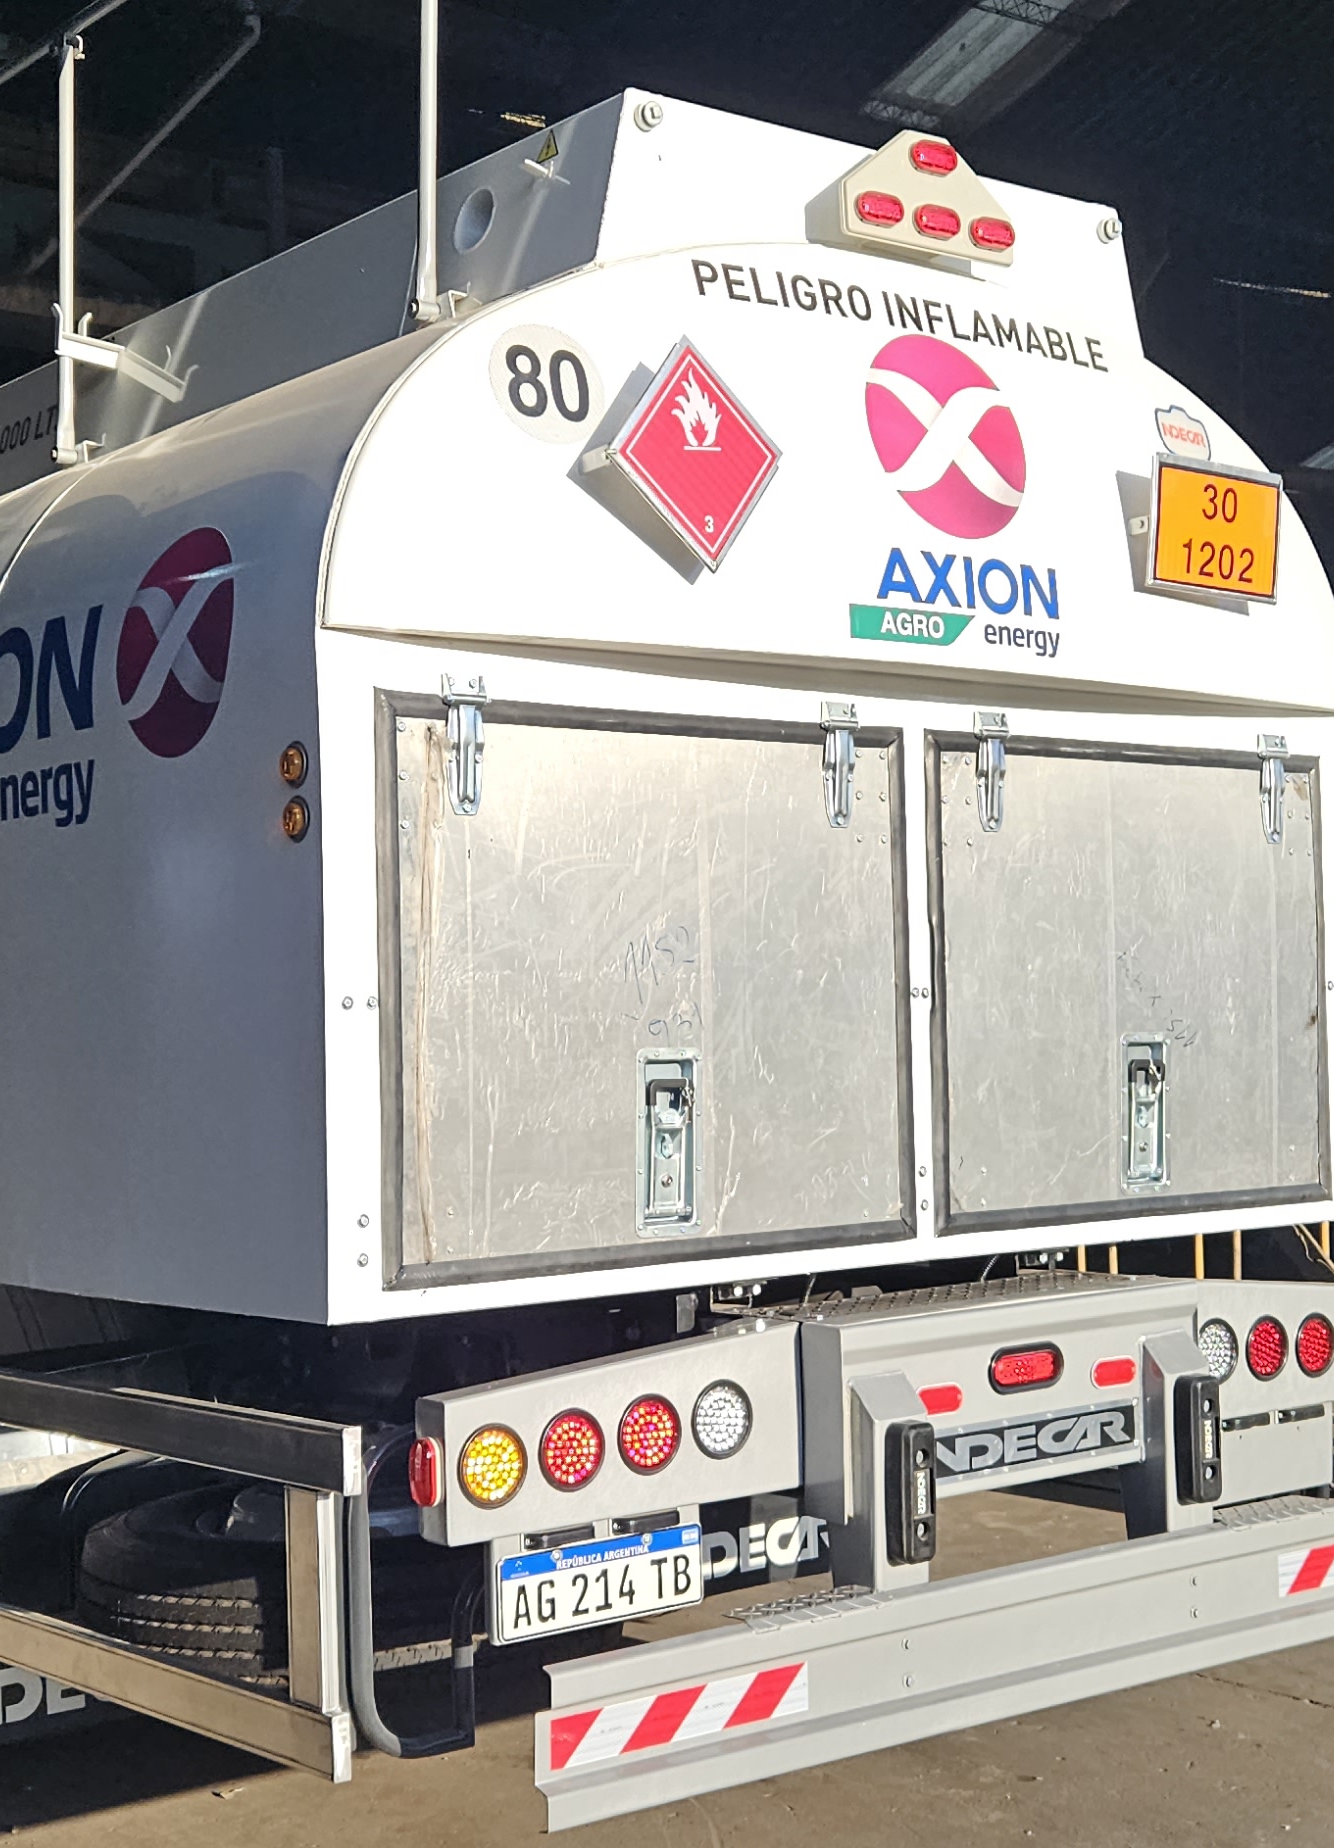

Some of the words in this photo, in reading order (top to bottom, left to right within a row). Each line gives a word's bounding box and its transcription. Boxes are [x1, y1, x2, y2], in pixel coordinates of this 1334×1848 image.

[691, 258, 872, 322] PELIGRO
[882, 290, 1109, 373] INFLAMABLE
[505, 344, 590, 423] 80
[33, 403, 60, 441] LT
[704, 515, 715, 533] 3
[1202, 483, 1238, 524] 30
[1182, 537, 1255, 584] 1202
[877, 547, 1060, 619] AXION
[880, 610, 946, 638] AGRO
[984, 623, 1060, 658] energy
[512, 1578, 556, 1630] AG
[571, 1563, 636, 1618] 214
[650, 1553, 692, 1600] TB
